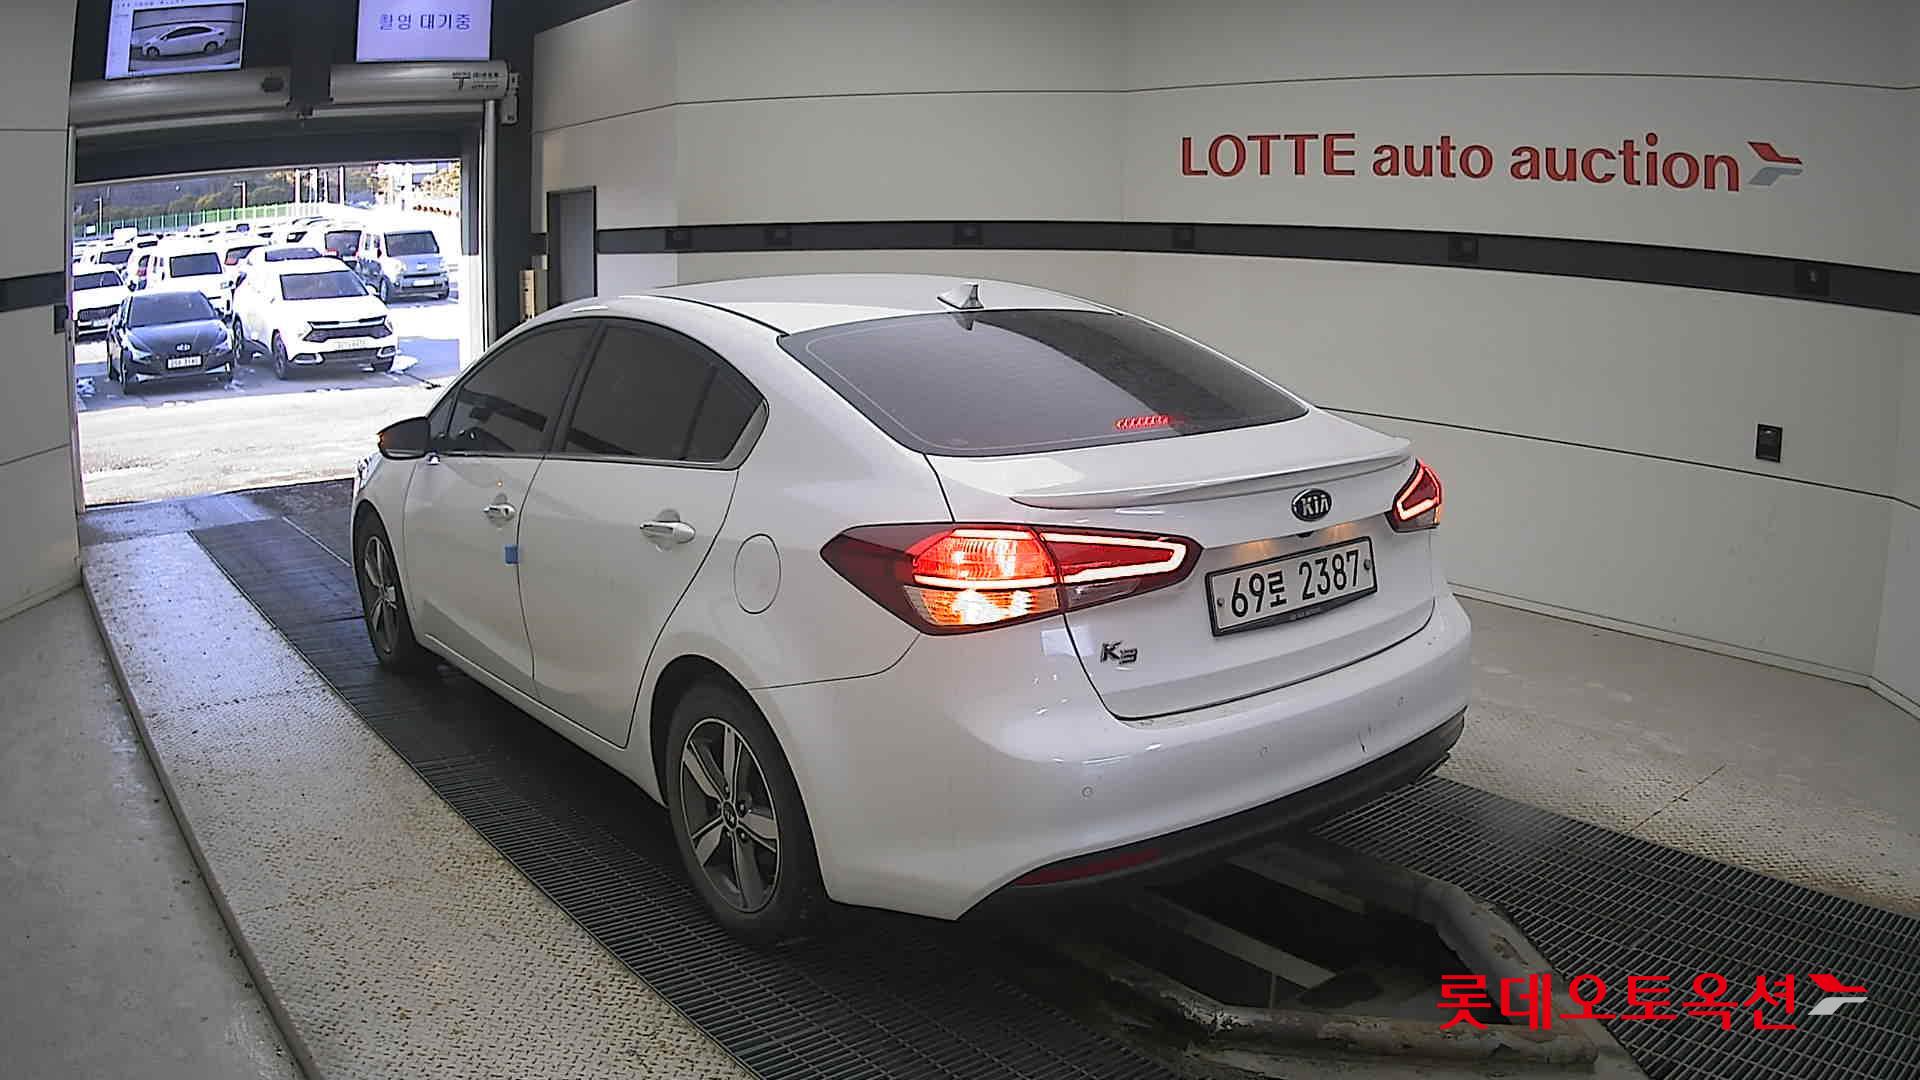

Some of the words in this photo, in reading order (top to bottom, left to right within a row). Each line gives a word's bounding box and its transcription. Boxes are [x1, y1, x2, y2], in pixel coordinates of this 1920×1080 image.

[420, 13, 470, 31] 대기중
[1180, 132, 1356, 177] LOTTE
[1372, 135, 1494, 179] auto
[1510, 132, 1740, 192] auction
[1300, 494, 1330, 516] KIA
[1231, 570, 1287, 618] 69로
[1299, 549, 1360, 600] 2387
[1100, 641, 1137, 664] K3
